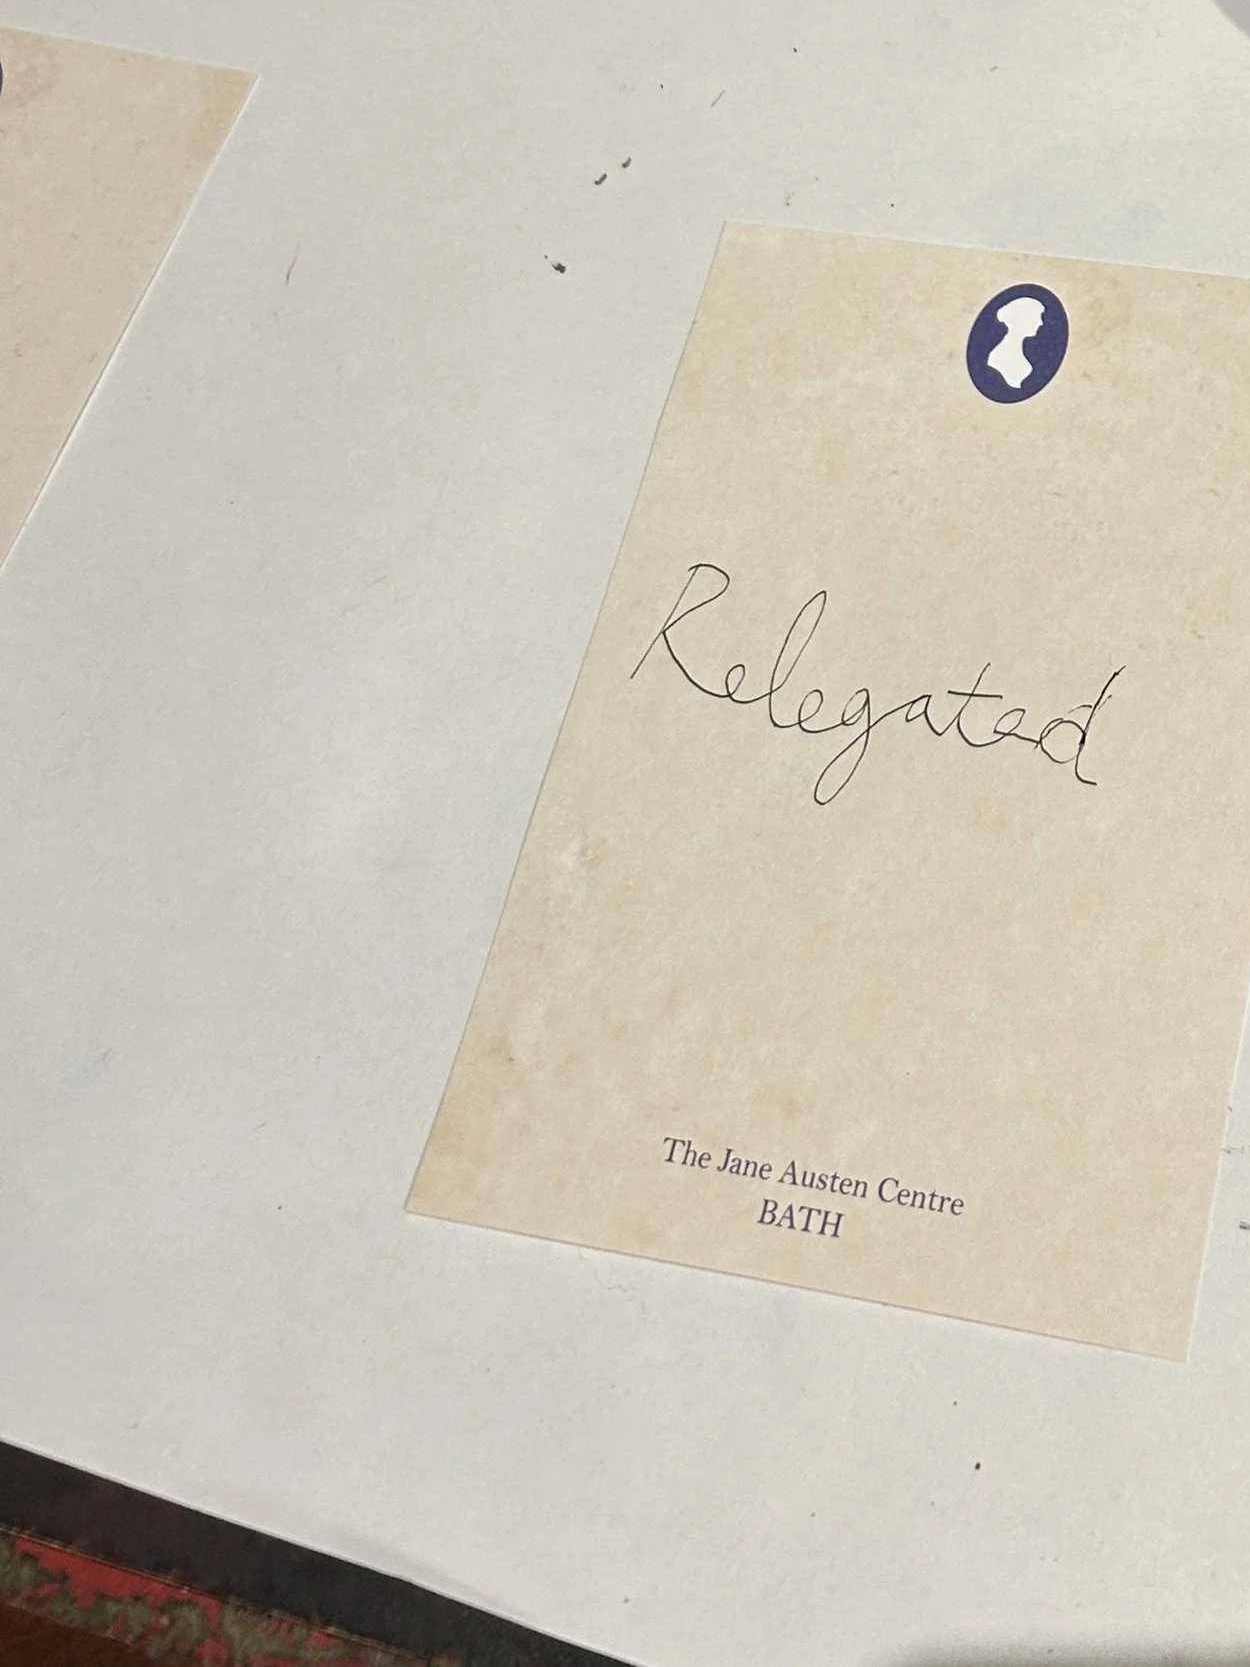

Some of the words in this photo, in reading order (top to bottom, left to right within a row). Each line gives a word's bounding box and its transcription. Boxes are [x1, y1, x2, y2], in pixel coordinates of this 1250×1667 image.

[630, 563, 1127, 806] Relegated
[663, 1136, 713, 1170] The
[716, 1147, 774, 1181] Jane
[777, 1160, 869, 1199] Austen
[877, 1177, 966, 1217] Centre
[757, 1198, 846, 1239] BATH
